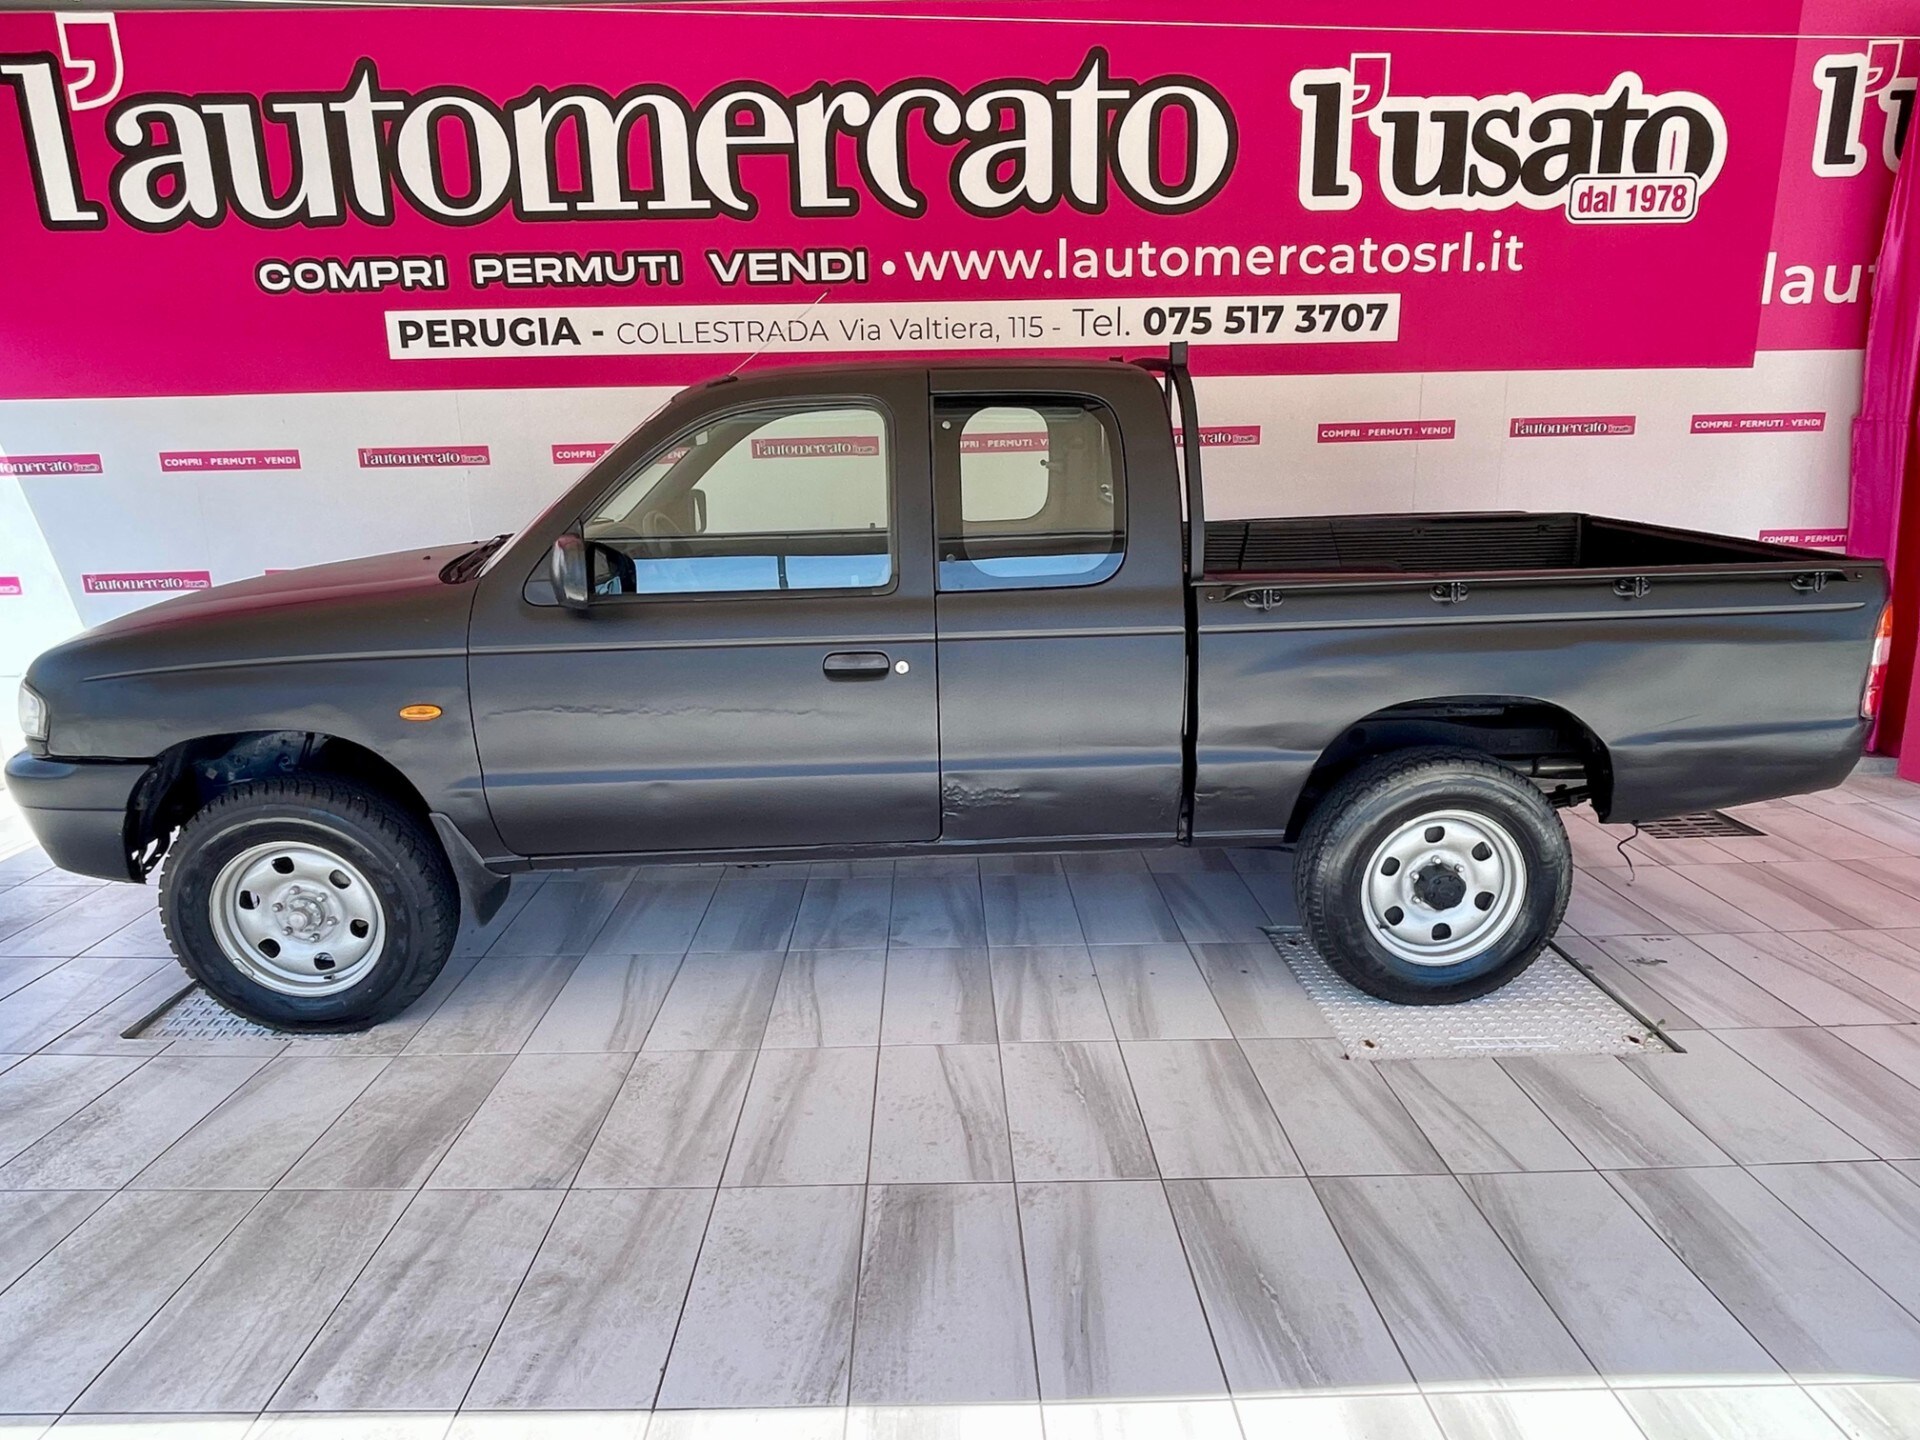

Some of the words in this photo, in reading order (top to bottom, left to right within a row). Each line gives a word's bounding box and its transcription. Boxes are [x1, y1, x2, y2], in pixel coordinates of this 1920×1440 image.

[0, 12, 1237, 230] l'automercato
[1296, 53, 1722, 206] l'usato
[1578, 185, 1617, 213] dal
[1626, 184, 1687, 212] 1978
[256, 257, 447, 292] COMPRI
[472, 253, 682, 287] PERMUTI
[706, 250, 868, 284] VENDI
[905, 230, 1524, 281] www.lautomercatosrl.it
[1761, 252, 1881, 305] lau
[398, 317, 581, 348] PERUGIA
[617, 319, 830, 345] COLLESTRADA
[839, 318, 881, 341] Via
[889, 317, 1001, 342] Valtiera,
[1008, 316, 1044, 338] 115
[1072, 306, 1131, 337] Tel.
[1143, 306, 1213, 335] 075
[1223, 304, 1285, 334] 517
[1294, 302, 1389, 333] 3707
[1514, 418, 1607, 435] l'automercato
[1694, 421, 1733, 429] COMPRI
[1739, 419, 1784, 428] PERMUTI
[1790, 418, 1822, 427] VENDI
[1321, 429, 1360, 438] COMPRI
[1367, 428, 1413, 437] PERMUTI
[1420, 426, 1452, 435] VENDI
[755, 439, 852, 456] l'automercato
[988, 439, 1033, 448] PERMUTI
[164, 458, 203, 467] COMPRI
[210, 457, 257, 466] PERMUTI
[264, 456, 296, 465] VENDI
[362, 449, 460, 465] l'automercato
[556, 450, 596, 459] COMPRI
[1761, 535, 1799, 544] COMPRI
[1804, 534, 1847, 543] PERMUTI
[86, 575, 183, 590] l'automercato
